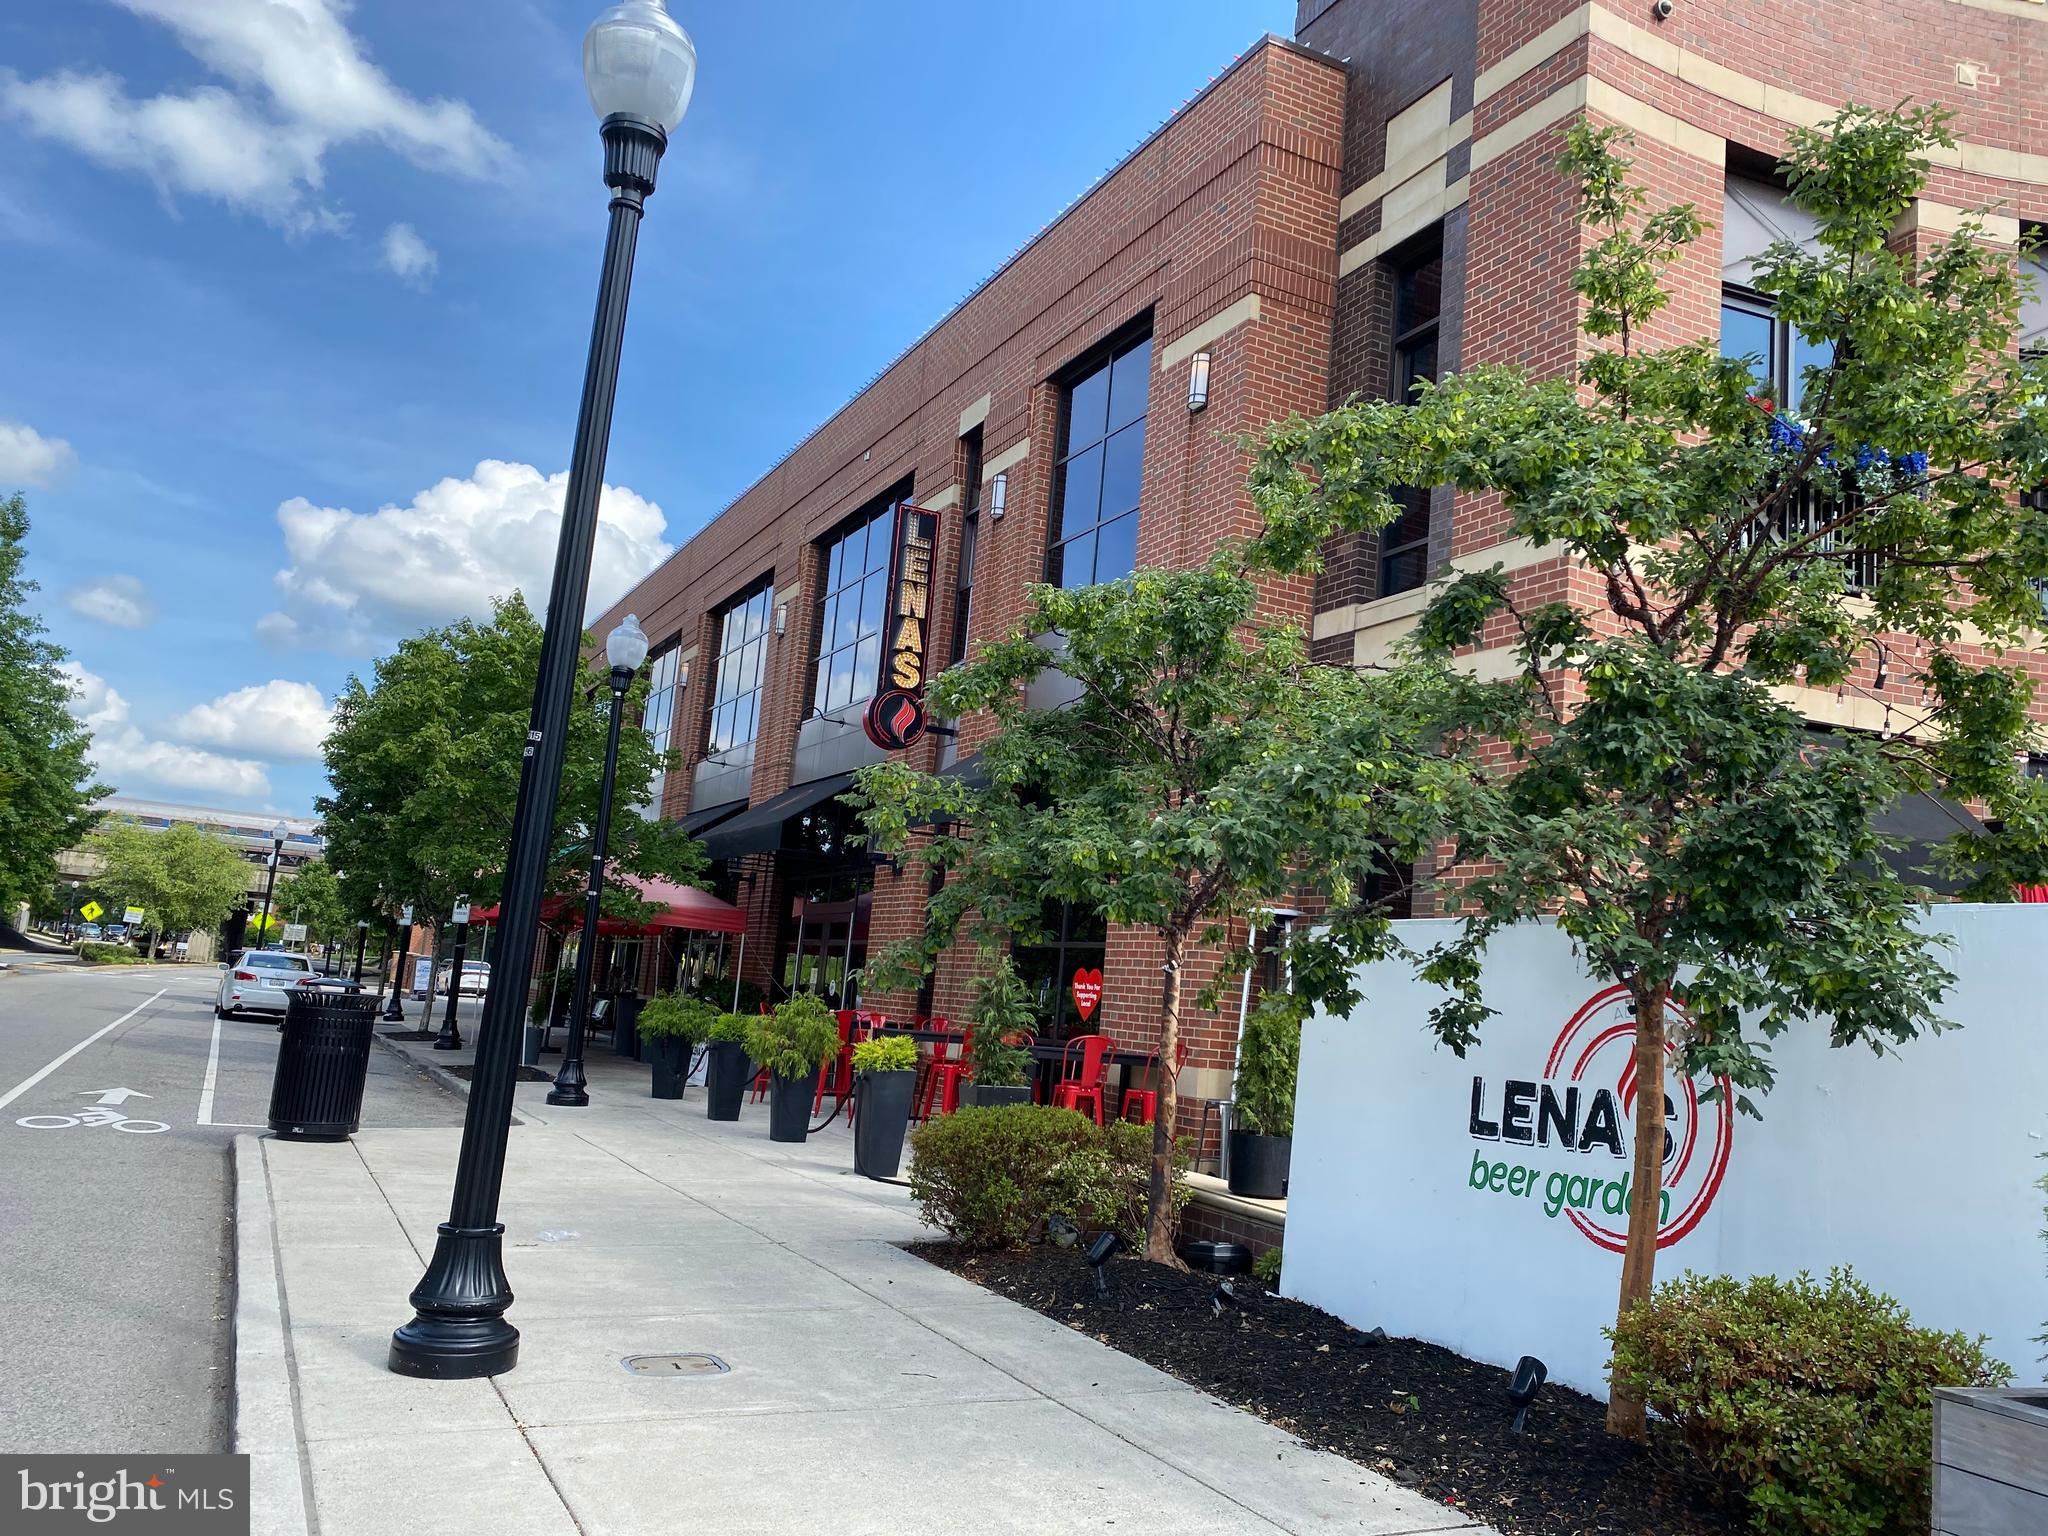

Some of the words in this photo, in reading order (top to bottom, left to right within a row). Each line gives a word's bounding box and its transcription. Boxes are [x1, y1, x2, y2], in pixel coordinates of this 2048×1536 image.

[891, 512, 932, 689] LENAS
[1074, 982, 1086, 990] Thank
[1076, 990, 1097, 1001] Supporting
[1469, 1149, 1540, 1198] beer
[1544, 1171, 1671, 1225] gardn
